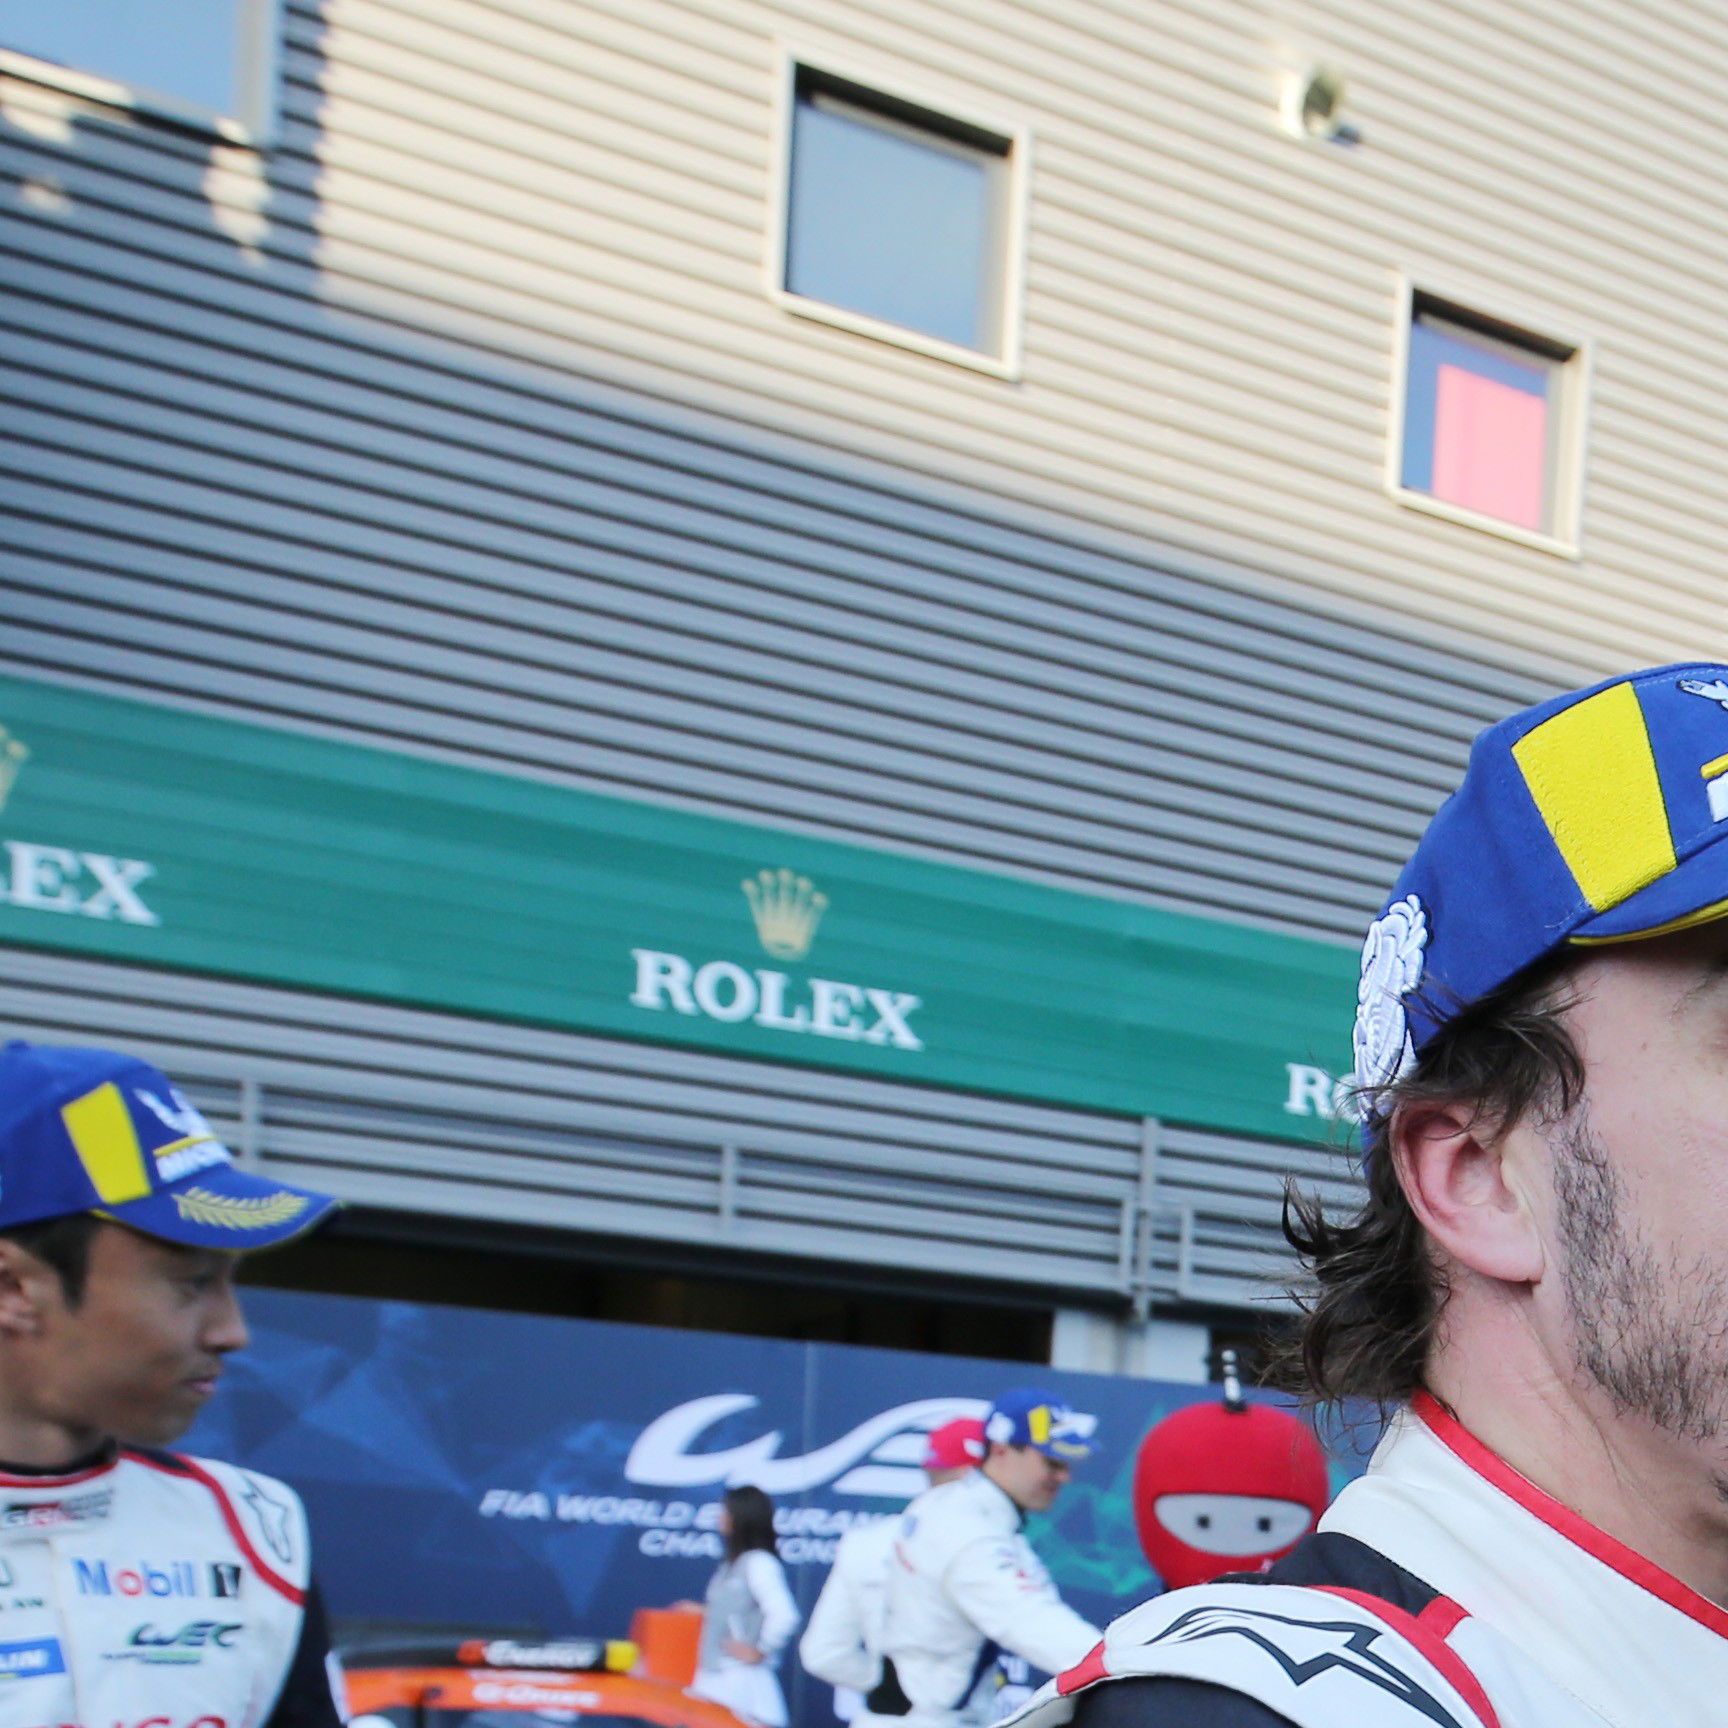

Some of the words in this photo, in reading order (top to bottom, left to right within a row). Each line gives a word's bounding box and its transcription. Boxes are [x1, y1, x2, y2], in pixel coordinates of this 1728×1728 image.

[631, 948, 923, 1051] ROLEX
[479, 1489, 552, 1521] FIA
[556, 1493, 694, 1531] WORLD
[73, 1557, 197, 1597] Mobil
[128, 1620, 244, 1648] WEC
